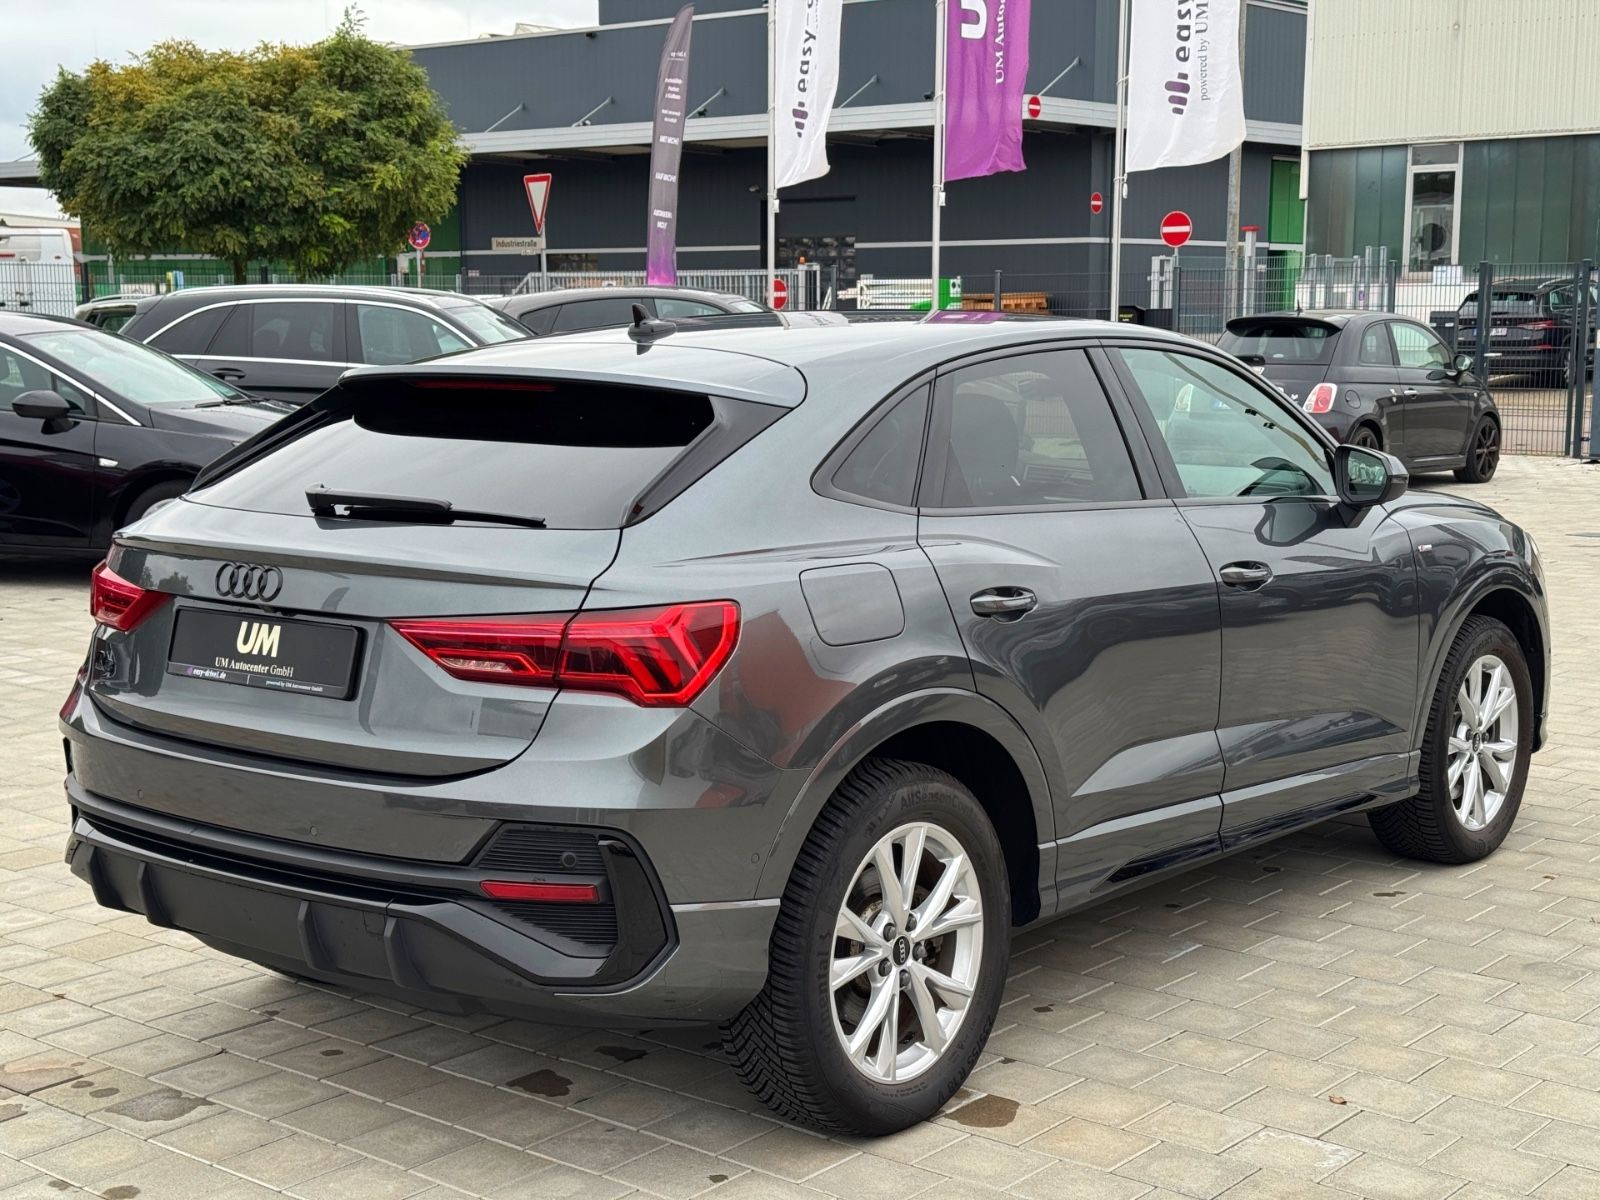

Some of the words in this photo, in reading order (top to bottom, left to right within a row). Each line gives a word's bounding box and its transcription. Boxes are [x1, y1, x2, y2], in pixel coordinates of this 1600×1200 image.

[1195, 2, 1209, 34] UM
[1197, 38, 1210, 53] by
[995, 50, 1005, 85] UM
[1199, 55, 1211, 101] powered
[236, 620, 282, 658] UM
[215, 656, 230, 669] UM
[229, 659, 269, 674] Autocenter
[270, 664, 295, 678] GmbH
